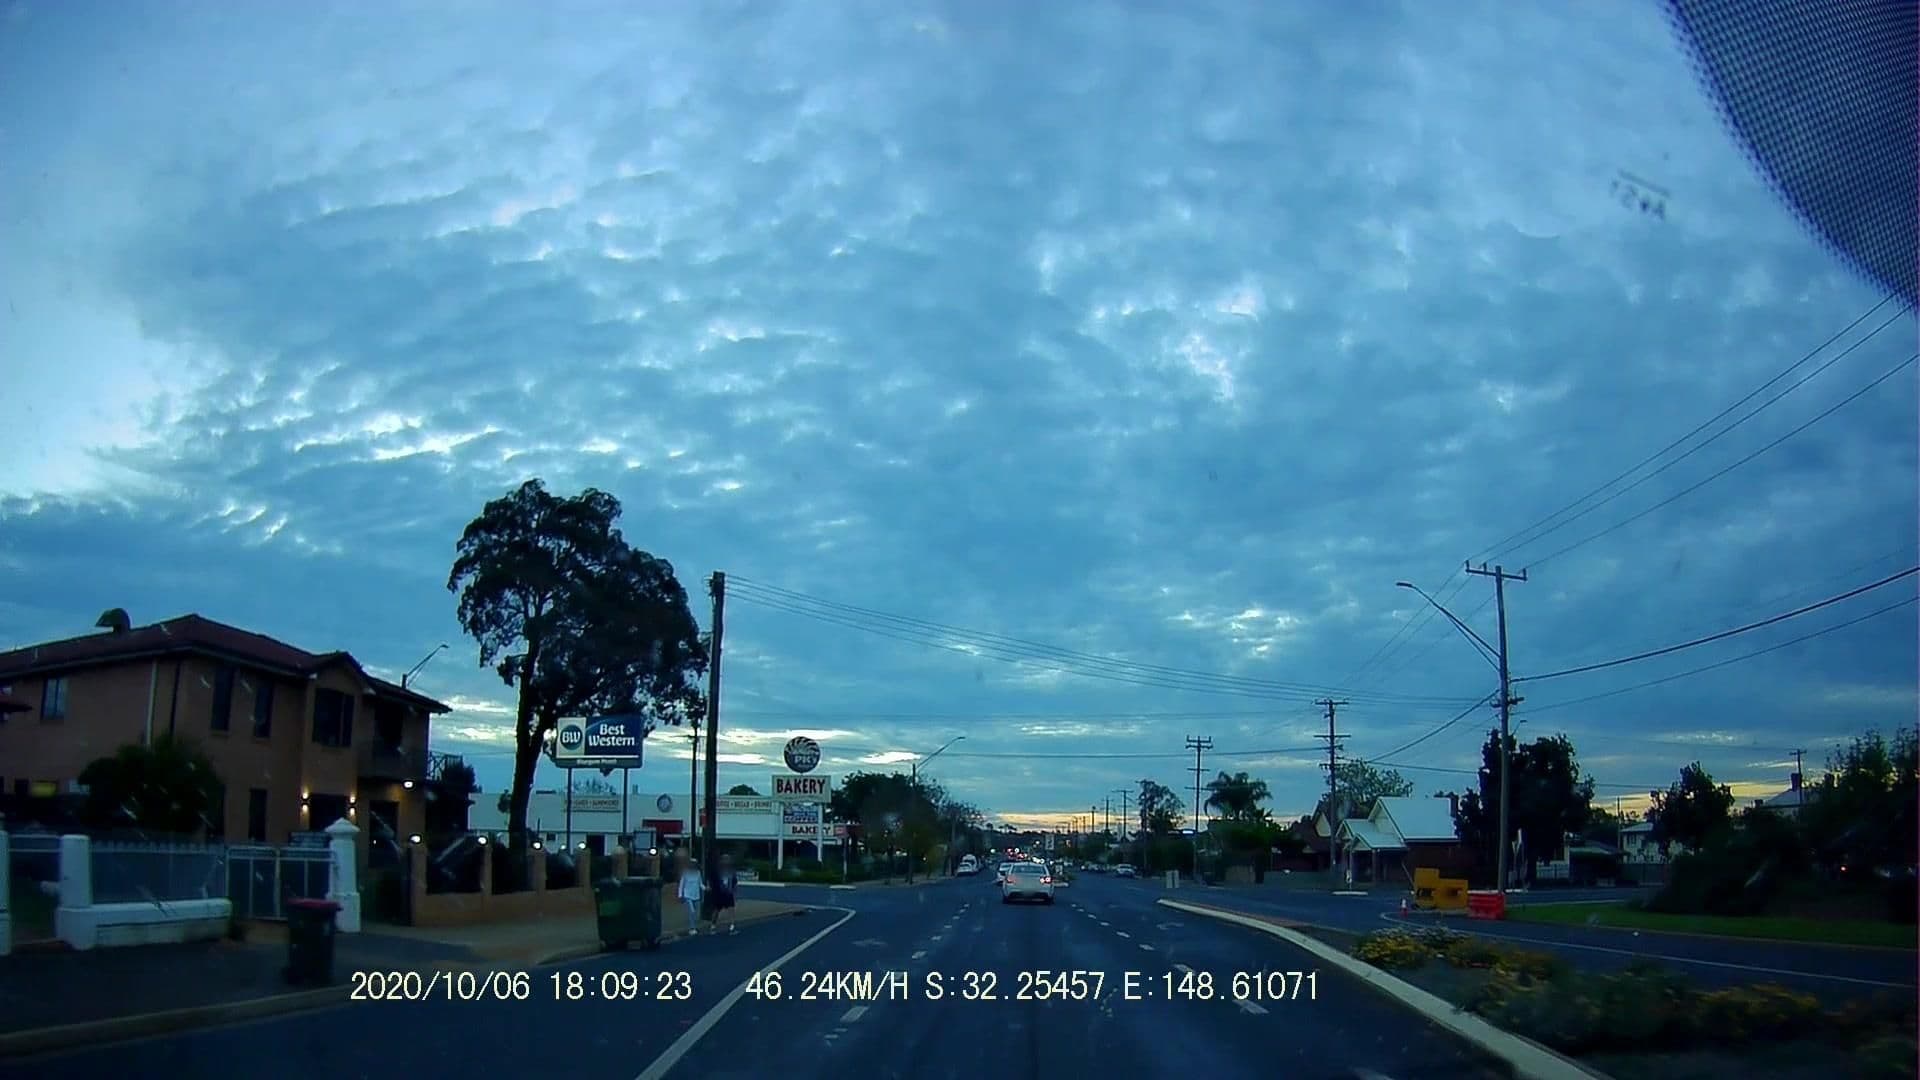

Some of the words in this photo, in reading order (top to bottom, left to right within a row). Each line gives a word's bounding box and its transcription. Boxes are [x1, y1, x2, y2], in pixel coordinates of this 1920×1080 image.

[600, 723, 625, 736] Best
[562, 731, 581, 744] BW
[588, 735, 636, 746] Western
[776, 778, 826, 795] BAKERY
[792, 825, 831, 835] BAKEY
